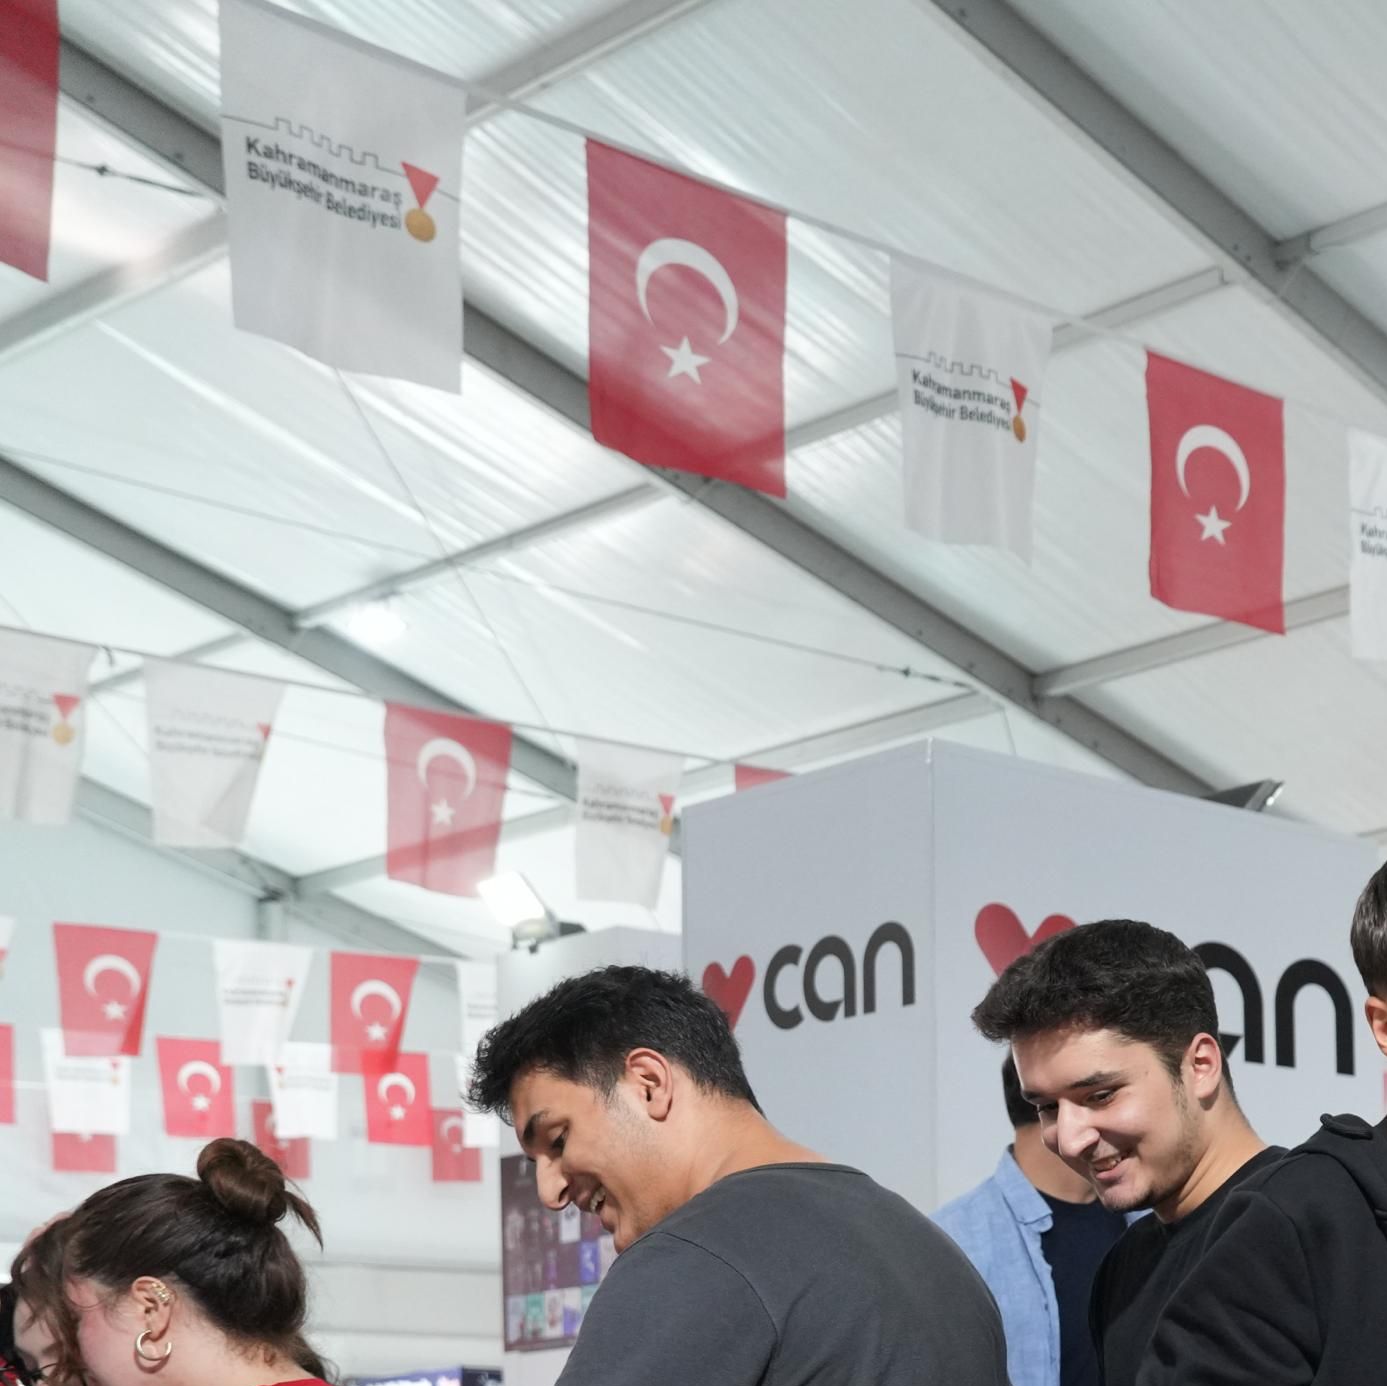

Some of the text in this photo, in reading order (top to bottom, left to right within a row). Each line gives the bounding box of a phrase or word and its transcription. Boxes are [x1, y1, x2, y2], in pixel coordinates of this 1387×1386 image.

[245, 136, 402, 210] Kahramanmaraş
[325, 192, 402, 230] Belediyesi
[763, 921, 916, 1031] can
[1189, 941, 1356, 1077] an
